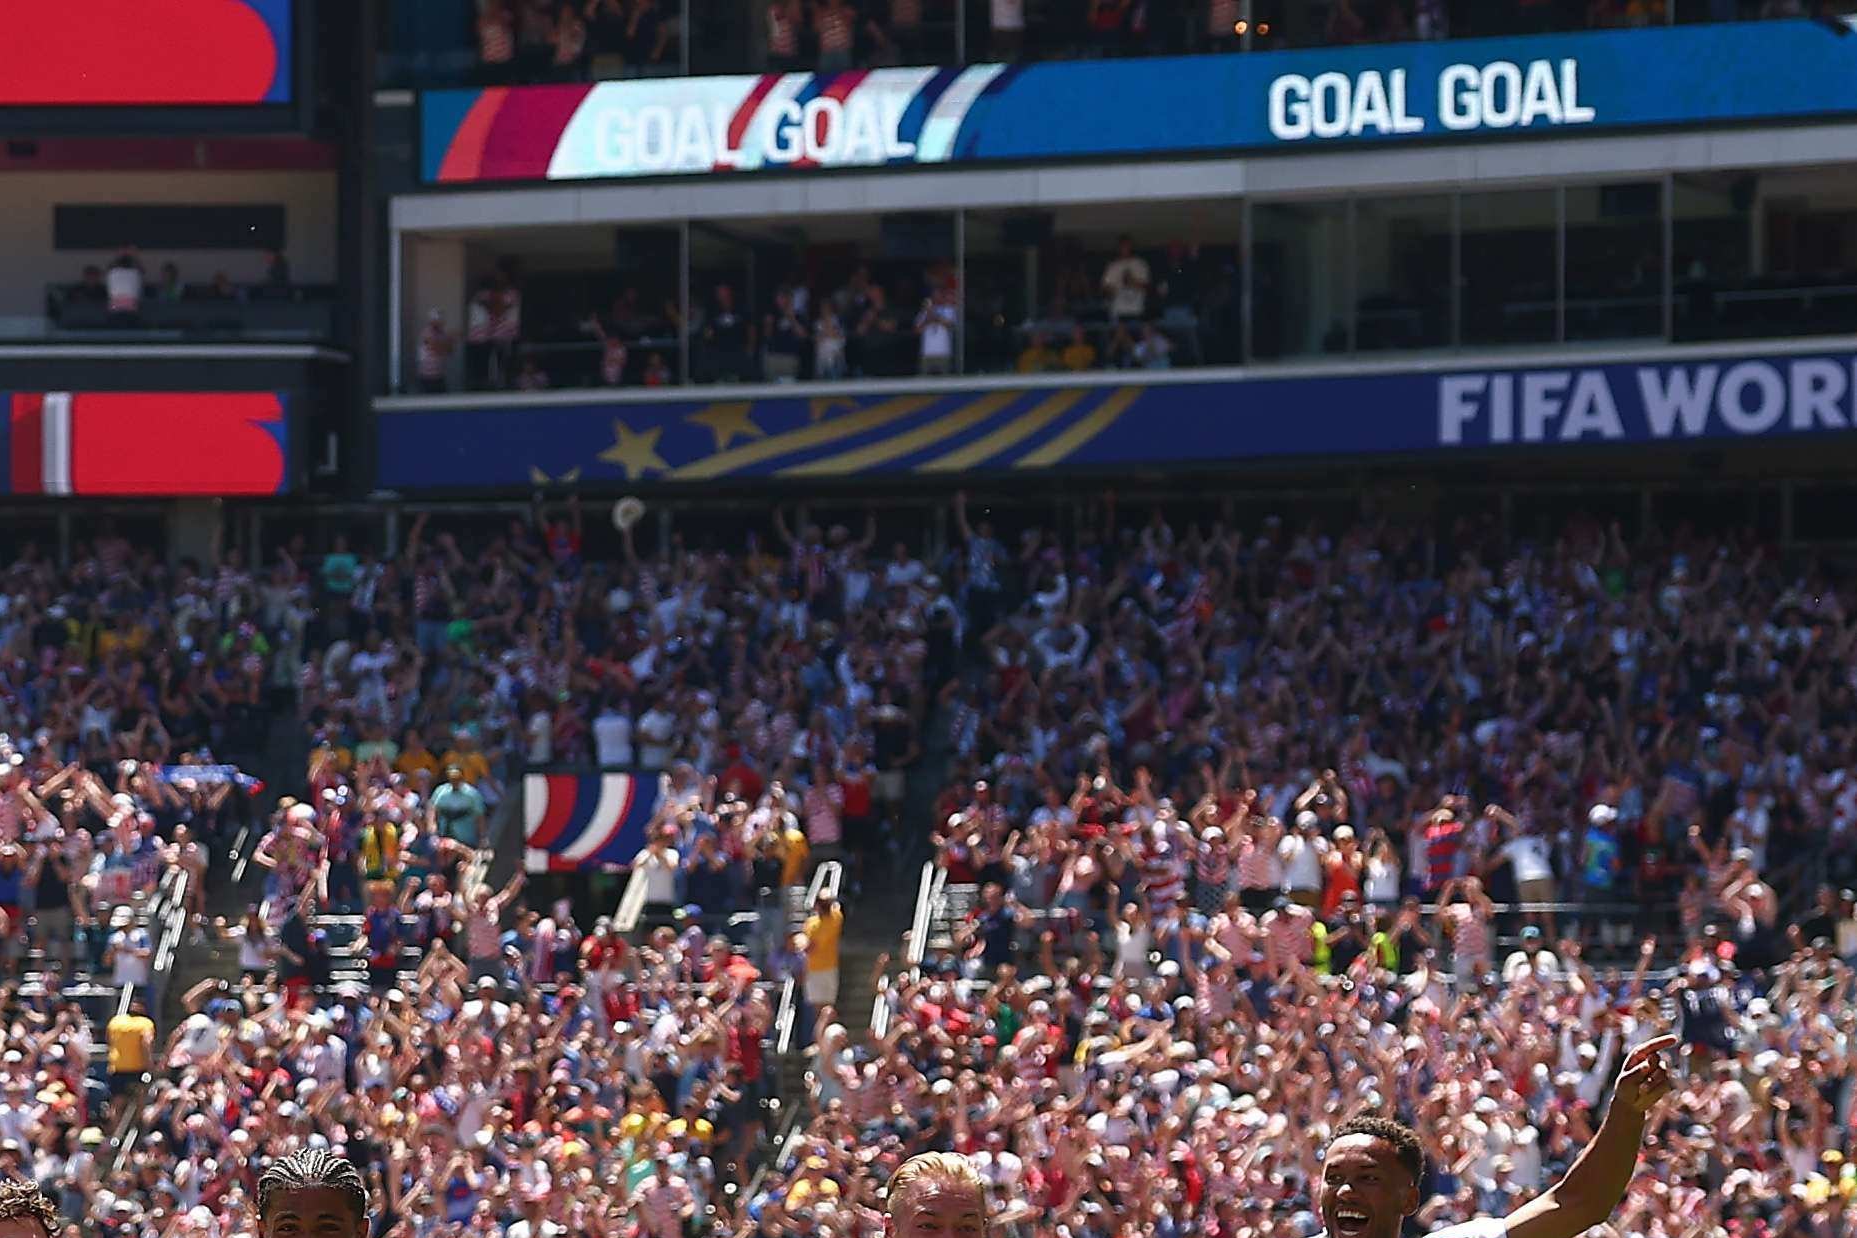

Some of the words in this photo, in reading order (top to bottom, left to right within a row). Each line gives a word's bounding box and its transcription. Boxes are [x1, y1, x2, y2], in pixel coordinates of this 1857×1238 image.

[595, 104, 742, 169] GOAL
[764, 95, 916, 163] GOAL
[1268, 68, 1425, 140] GOAL
[1438, 58, 1596, 131] GOAL
[1439, 369, 1625, 445] FIFA
[1637, 357, 1857, 436] WOR
